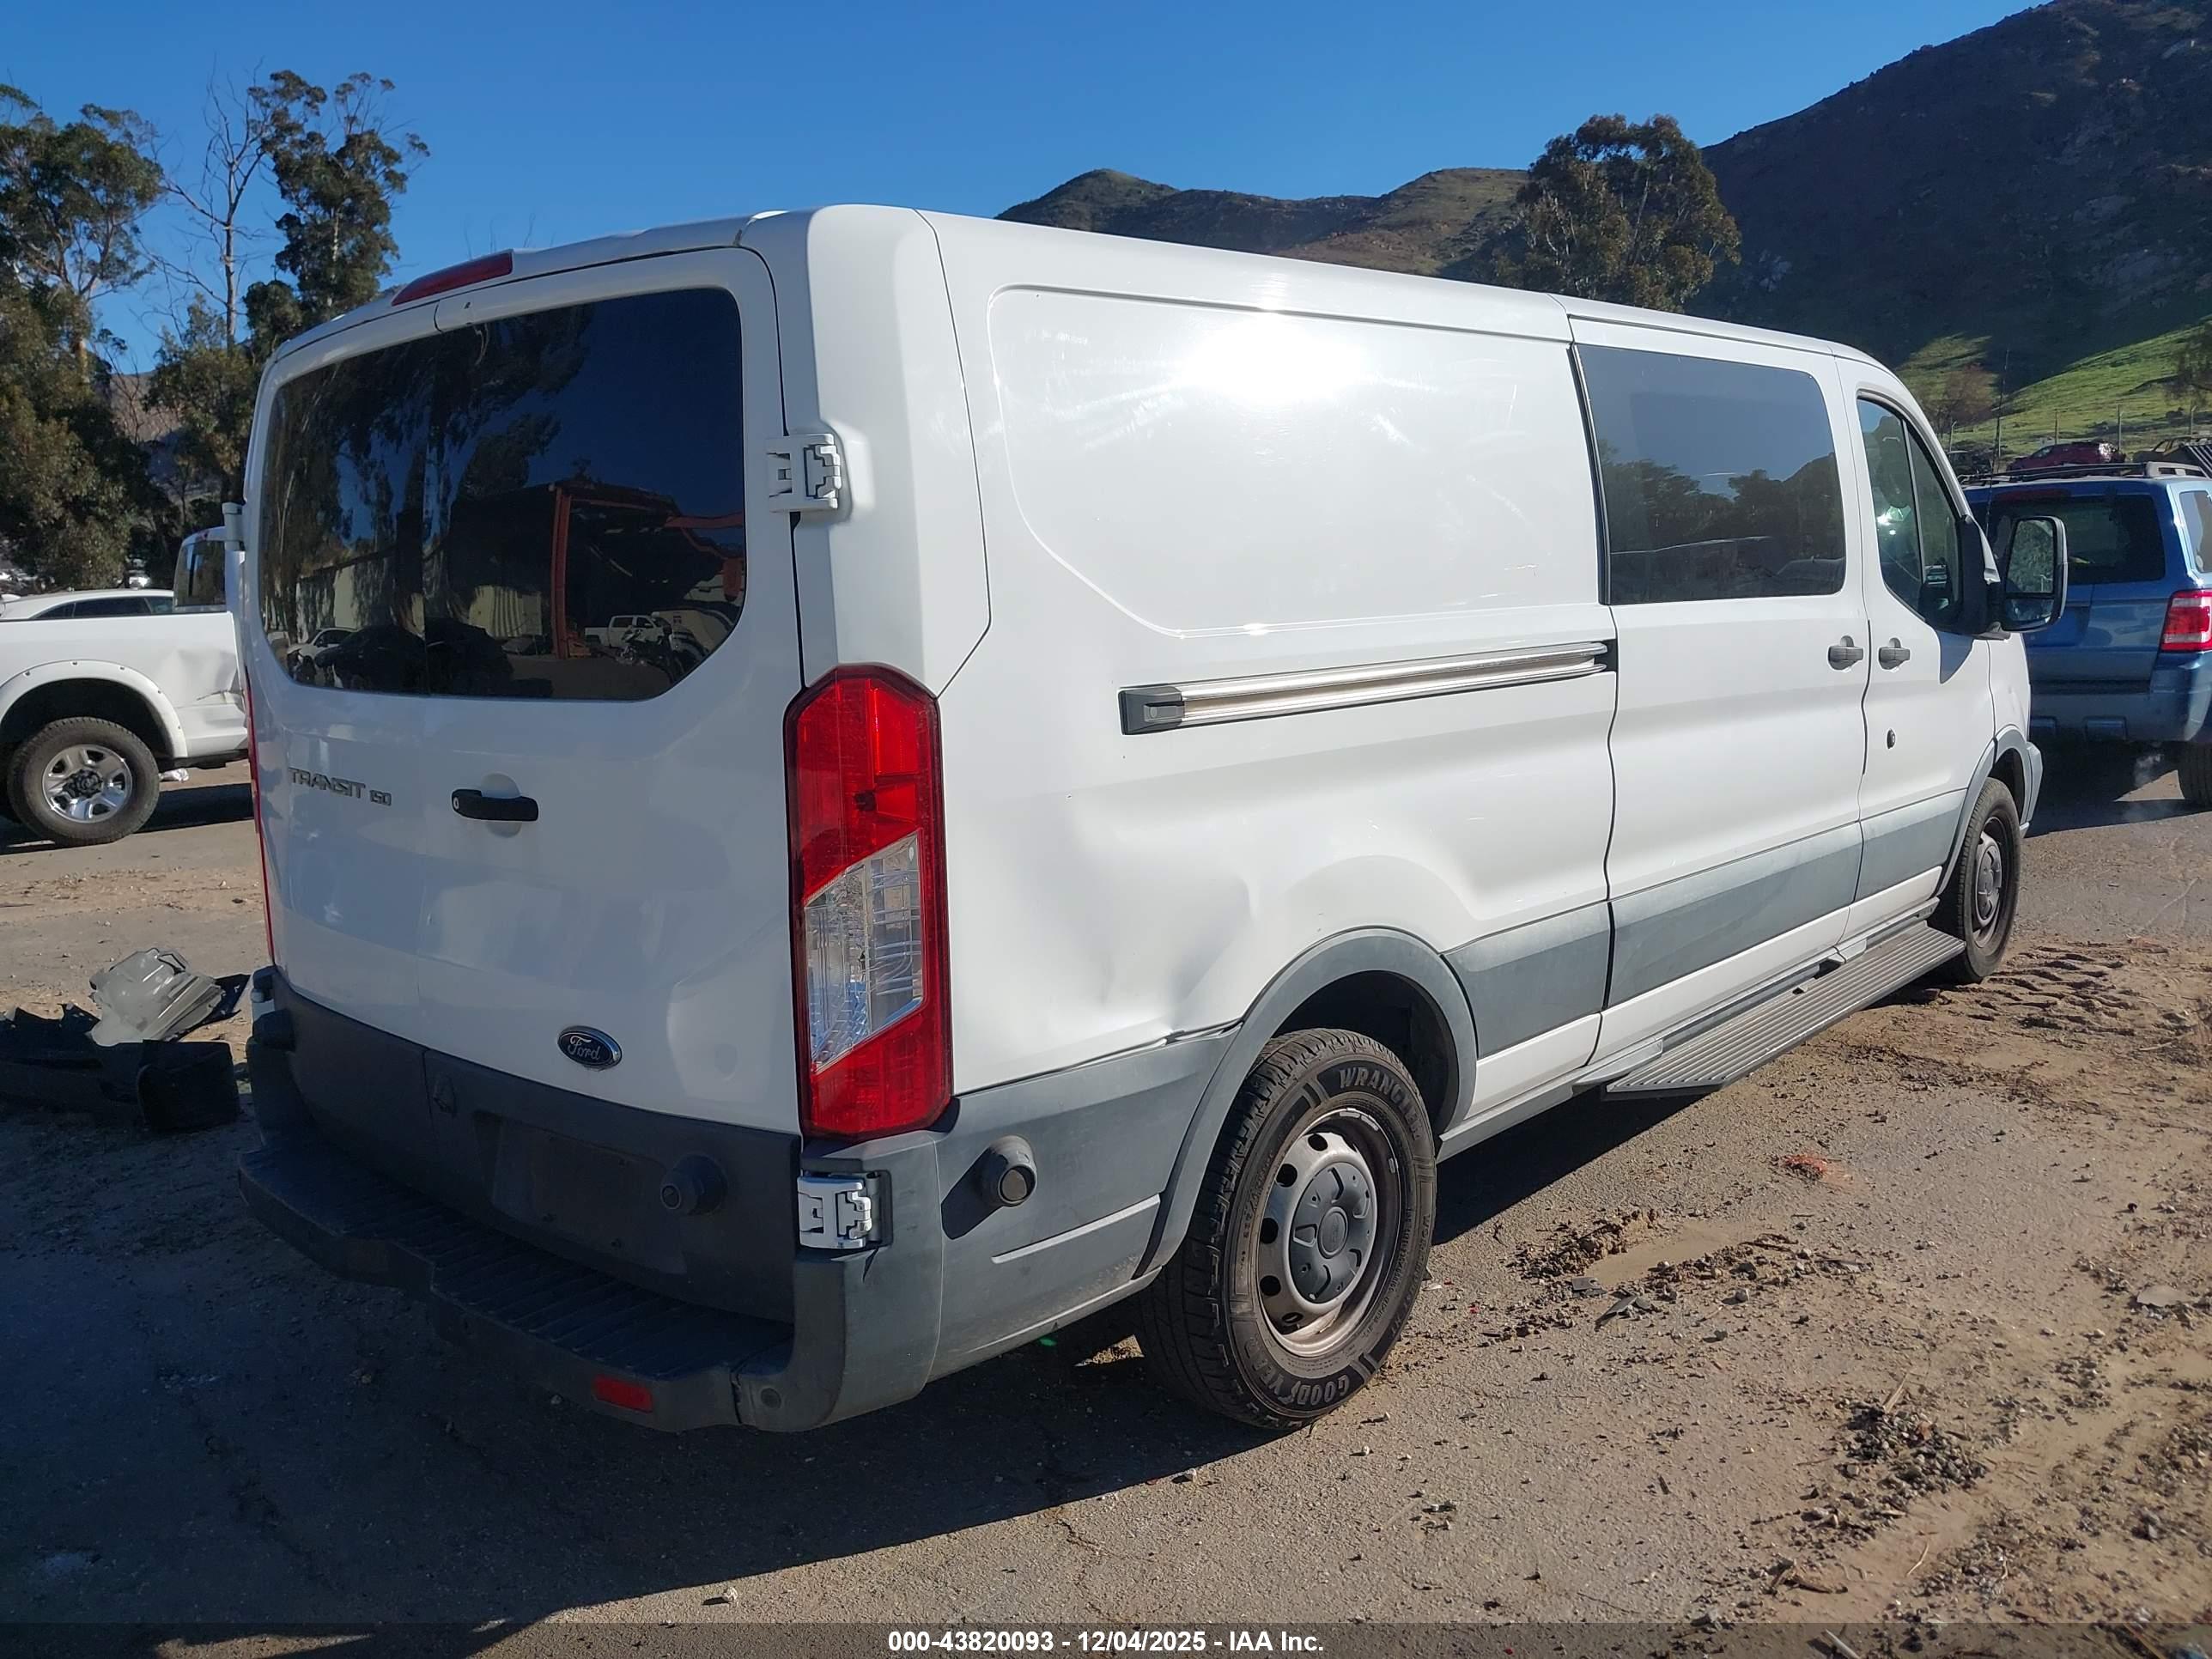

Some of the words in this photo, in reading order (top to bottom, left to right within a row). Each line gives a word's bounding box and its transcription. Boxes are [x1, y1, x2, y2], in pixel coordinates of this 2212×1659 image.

[288, 766, 366, 799] TRANSIT
[369, 788, 392, 807] 150
[568, 1035, 601, 1060] Ford
[1339, 1066, 1422, 1140] WRANGLER
[1244, 1336, 1350, 1406] GOODYEAR
